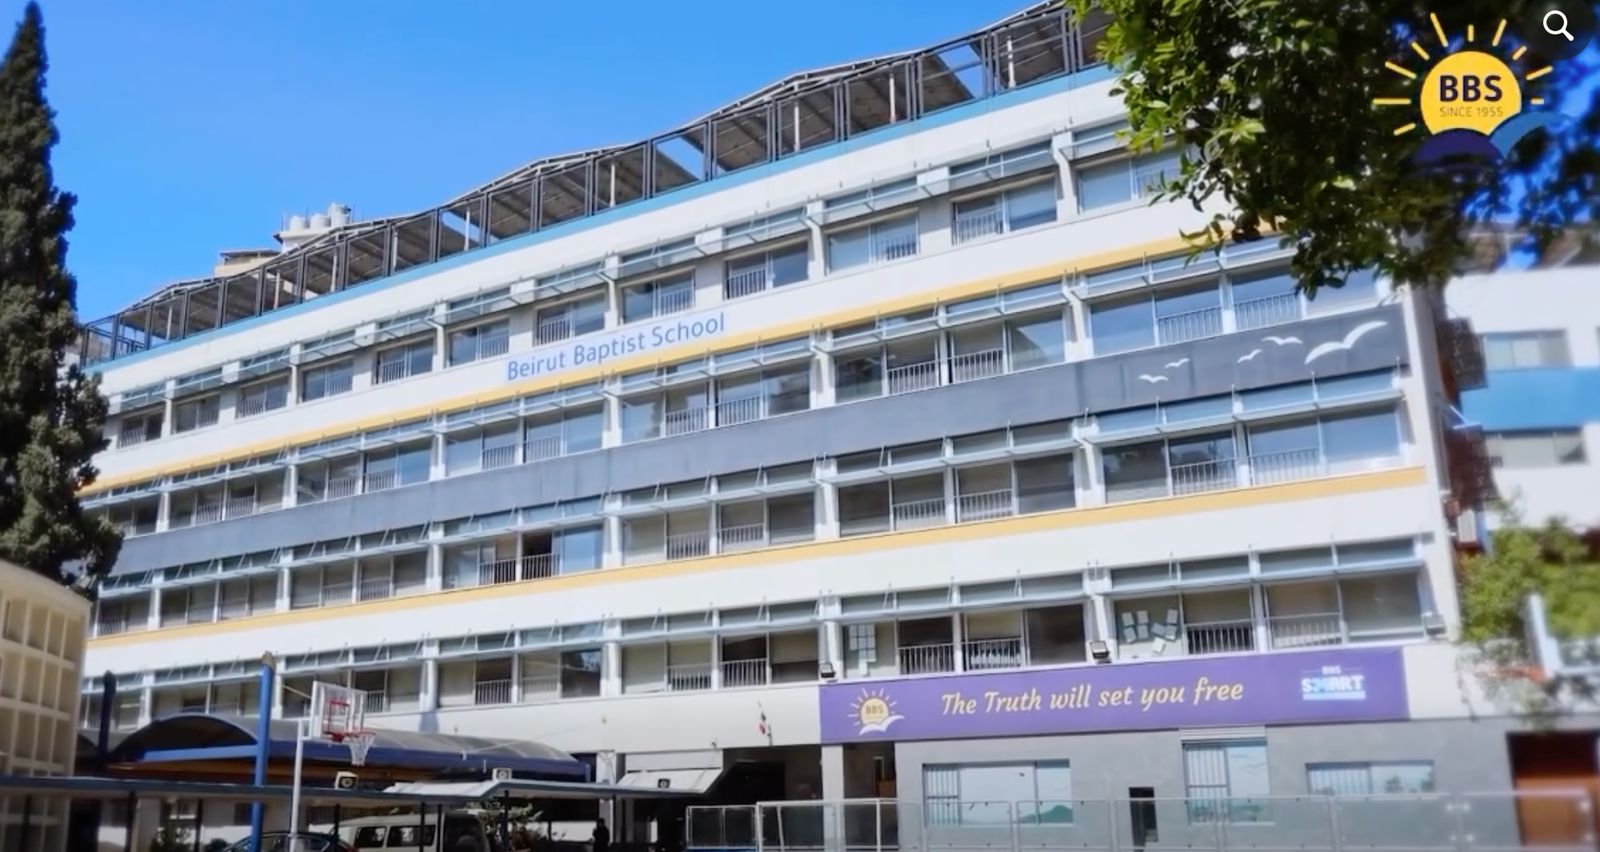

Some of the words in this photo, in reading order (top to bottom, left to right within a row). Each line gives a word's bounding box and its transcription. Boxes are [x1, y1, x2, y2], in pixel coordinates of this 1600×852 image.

[507, 351, 567, 381] Beirut
[573, 332, 645, 365] Baptist
[651, 312, 725, 347] School
[941, 691, 977, 715] The
[984, 687, 1041, 713] Truth
[1050, 683, 1092, 710] will
[1098, 685, 1134, 707] set
[1140, 686, 1185, 712] you
[1193, 676, 1244, 705] free
